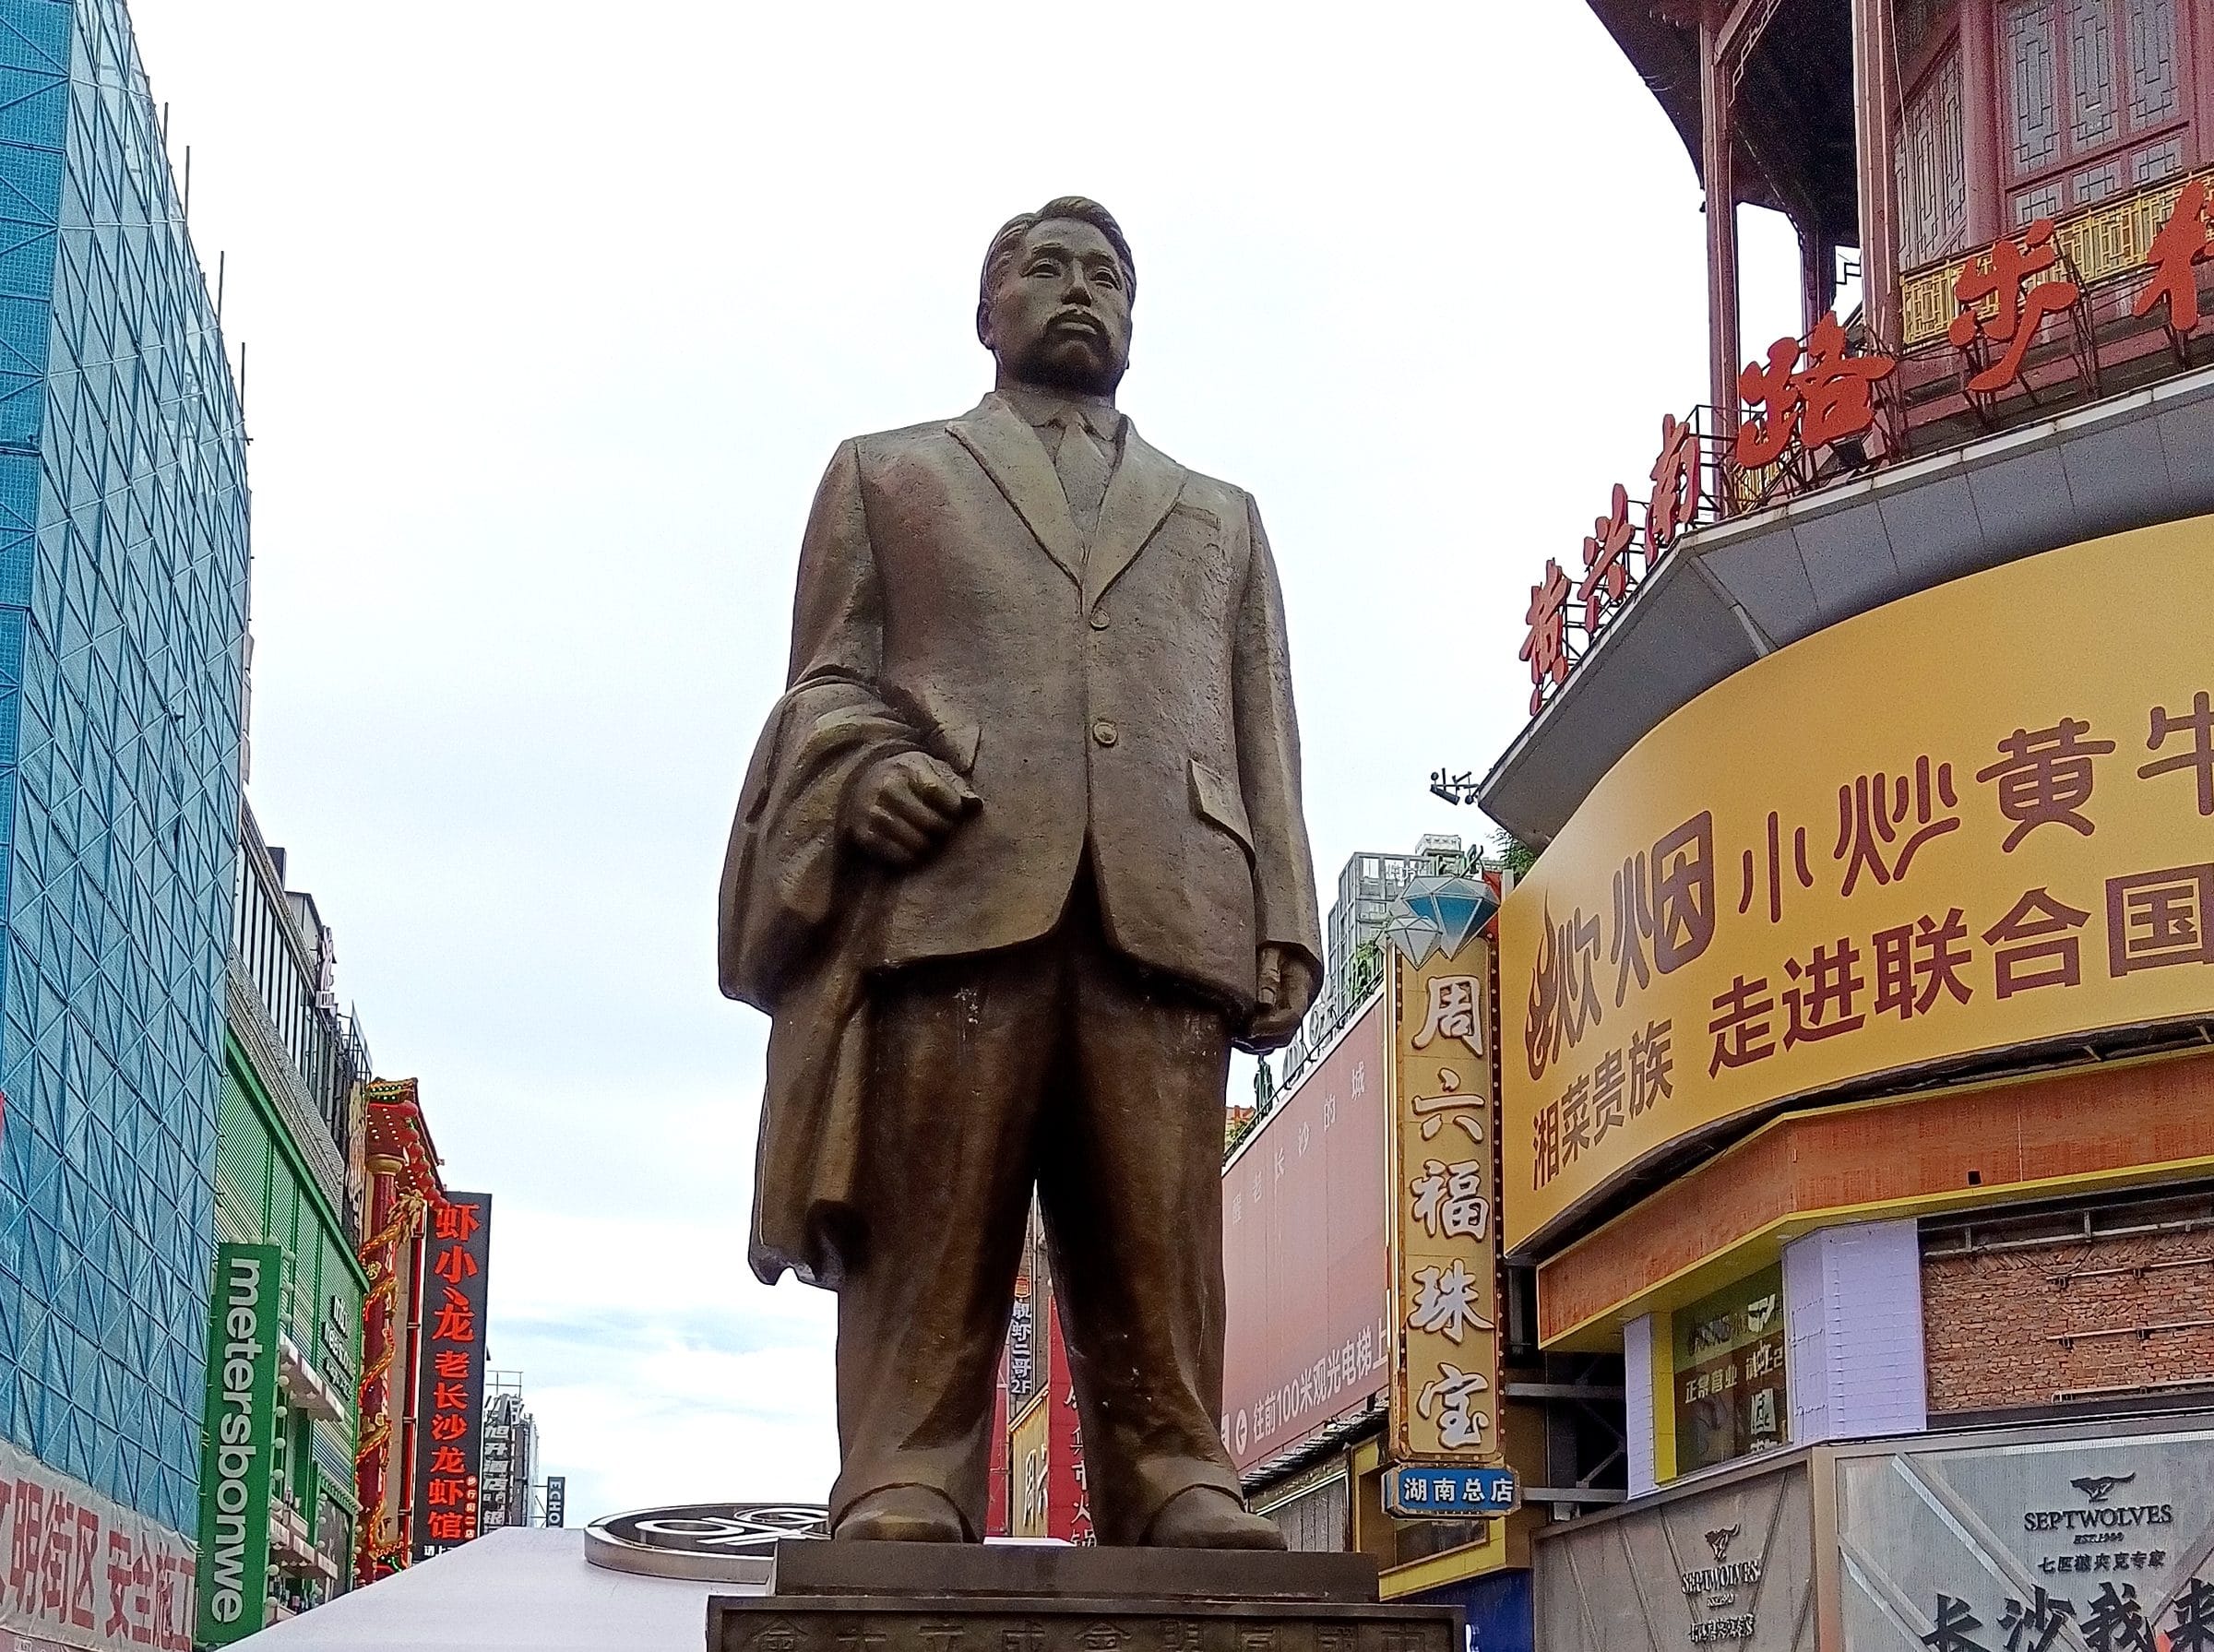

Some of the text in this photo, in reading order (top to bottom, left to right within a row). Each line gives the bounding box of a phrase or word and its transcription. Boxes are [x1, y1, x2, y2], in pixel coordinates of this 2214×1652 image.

[1708, 862, 2214, 1079] 走进联合国
[1532, 1017, 1673, 1191] 湘菜贵族
[1411, 975, 1495, 1452] 周六福珠宝
[210, 1256, 264, 1624] metersbonwe
[1403, 1478, 1514, 1503] 湖南总店
[106, 1529, 196, 1651] 安全施工
[1681, 1560, 1762, 1595] SEPTWOLVES
[2024, 1504, 2173, 1531] SEPTWOLVES
